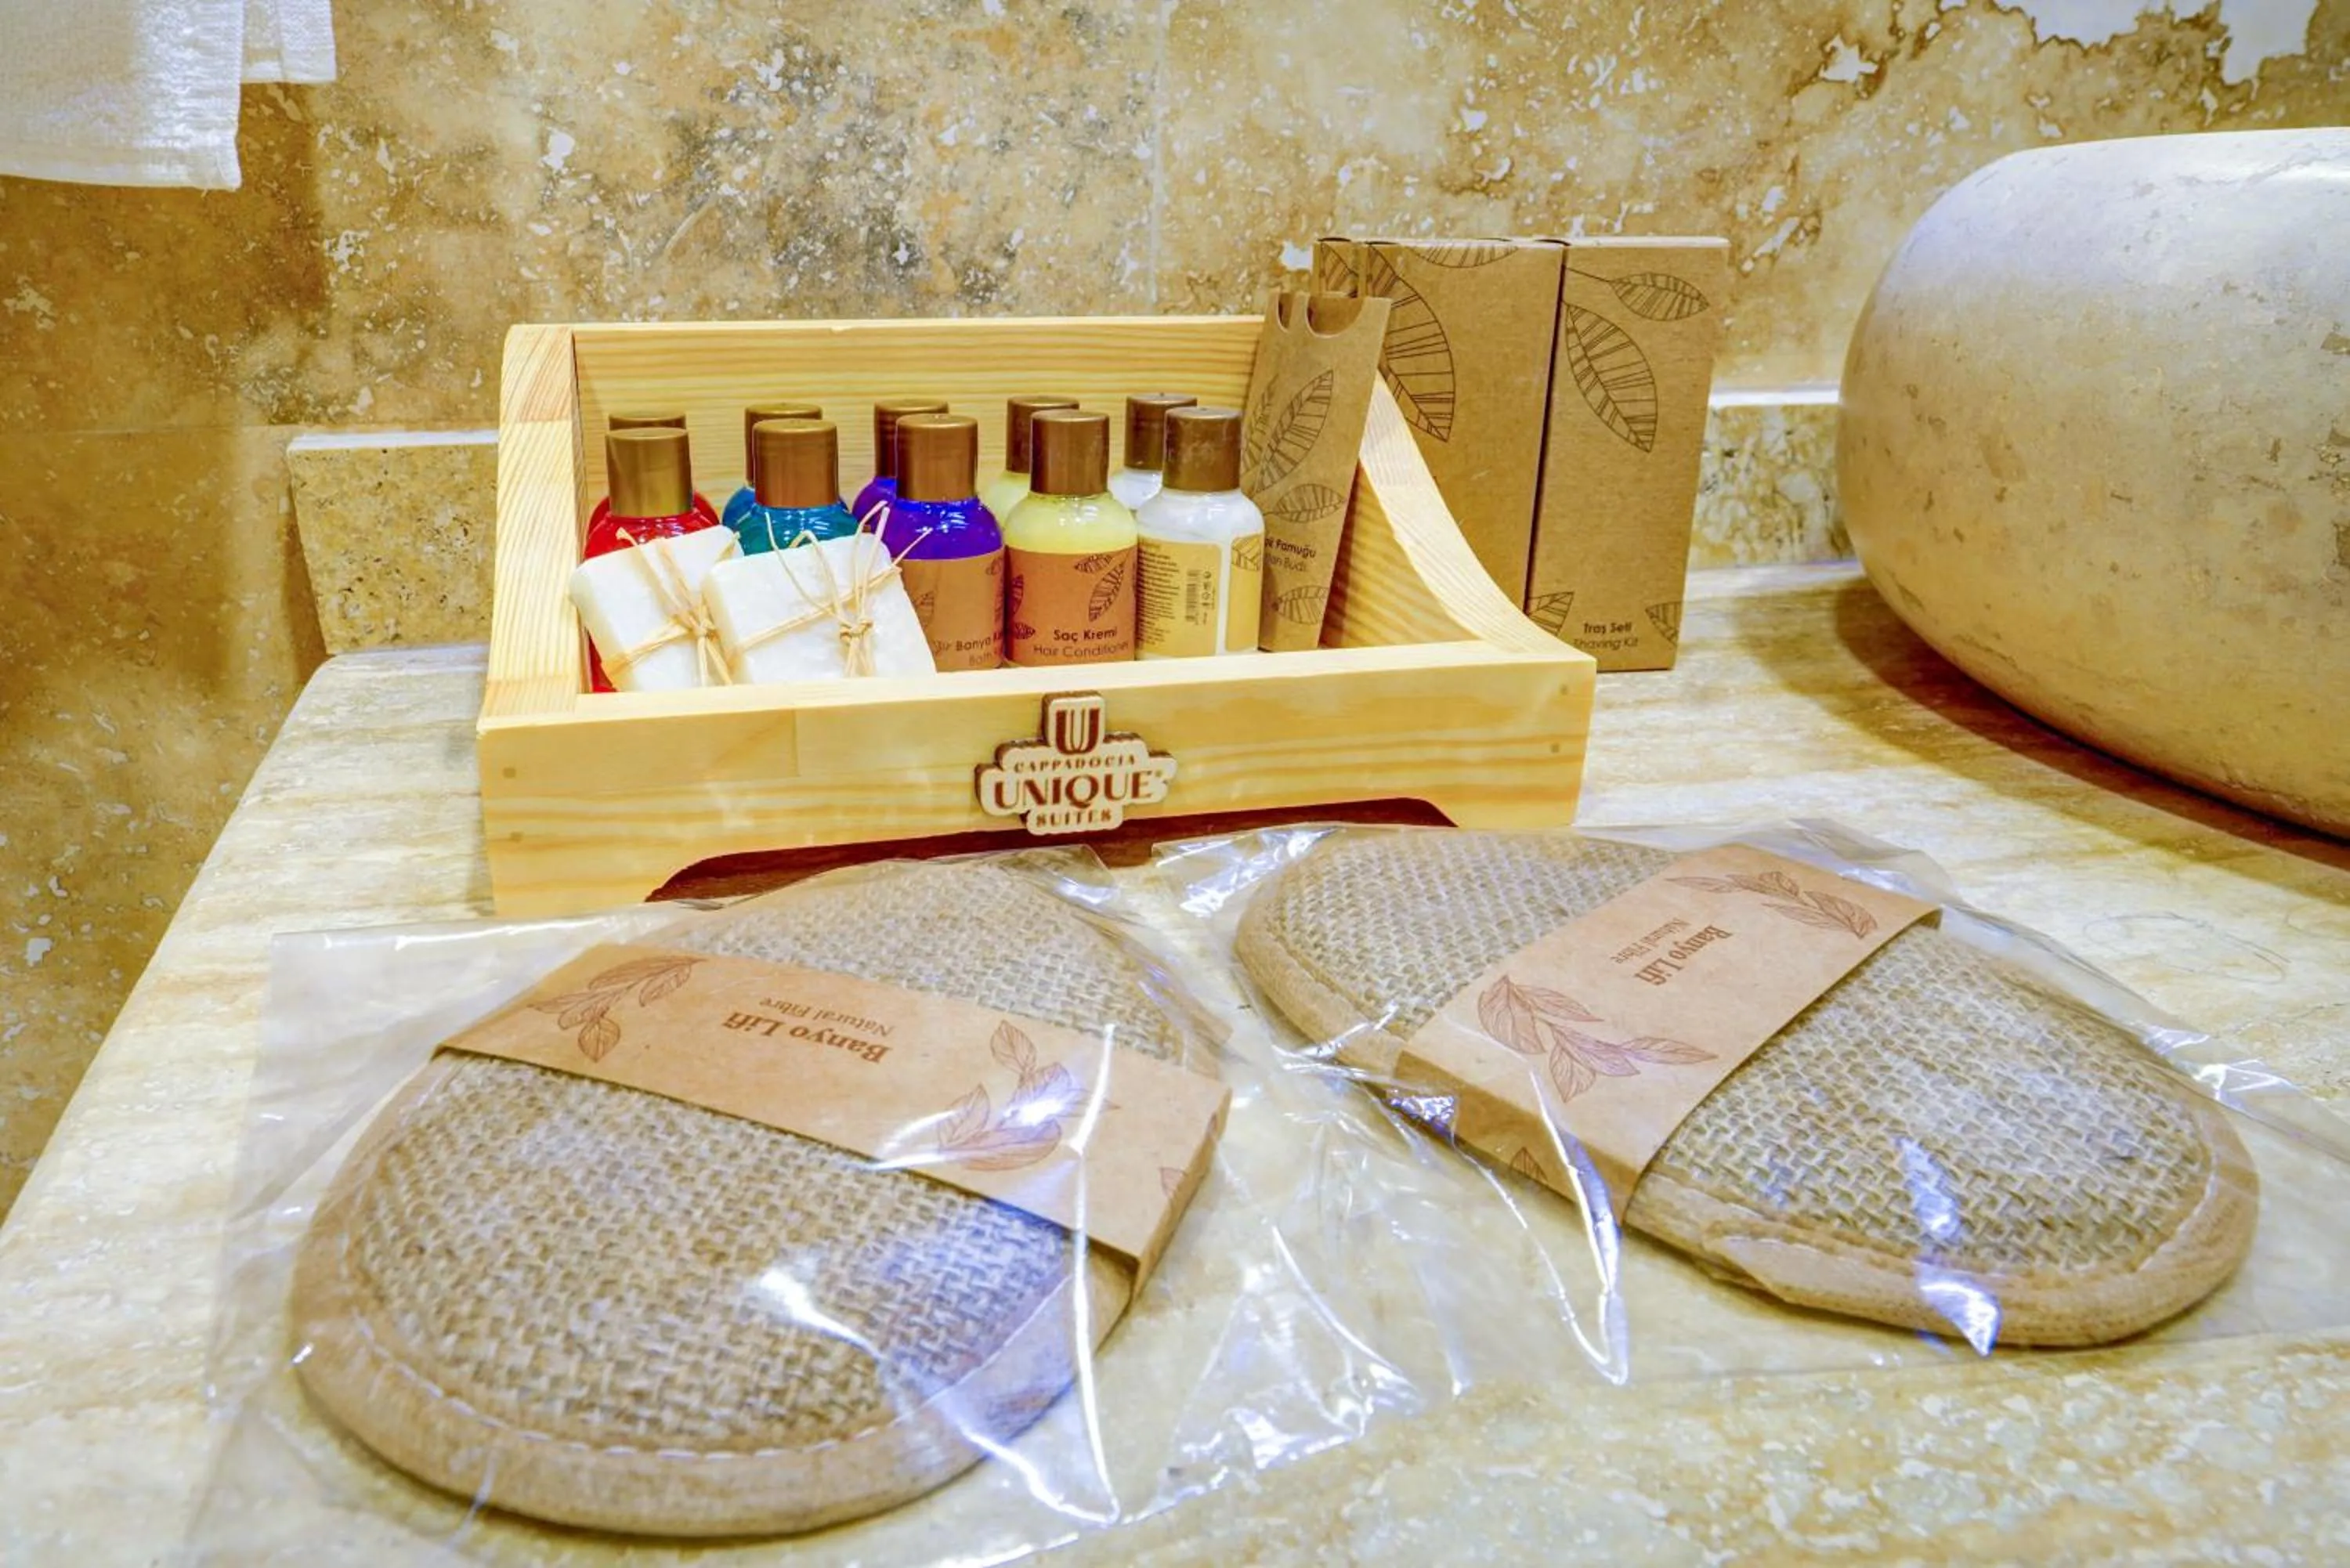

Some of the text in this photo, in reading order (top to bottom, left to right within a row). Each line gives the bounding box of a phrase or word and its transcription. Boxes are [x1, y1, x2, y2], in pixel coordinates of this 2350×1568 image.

[1053, 626, 1118, 643] Saç Kremi
[1032, 644, 1060, 656] Hair
[1014, 754, 1137, 774] CAPPADOCIA
[1036, 807, 1113, 827] SUITES
[1634, 924, 1734, 986] Banyo Lifi
[759, 996, 896, 1037] Natural Fibre
[721, 1011, 893, 1064] Banyo Lifi
